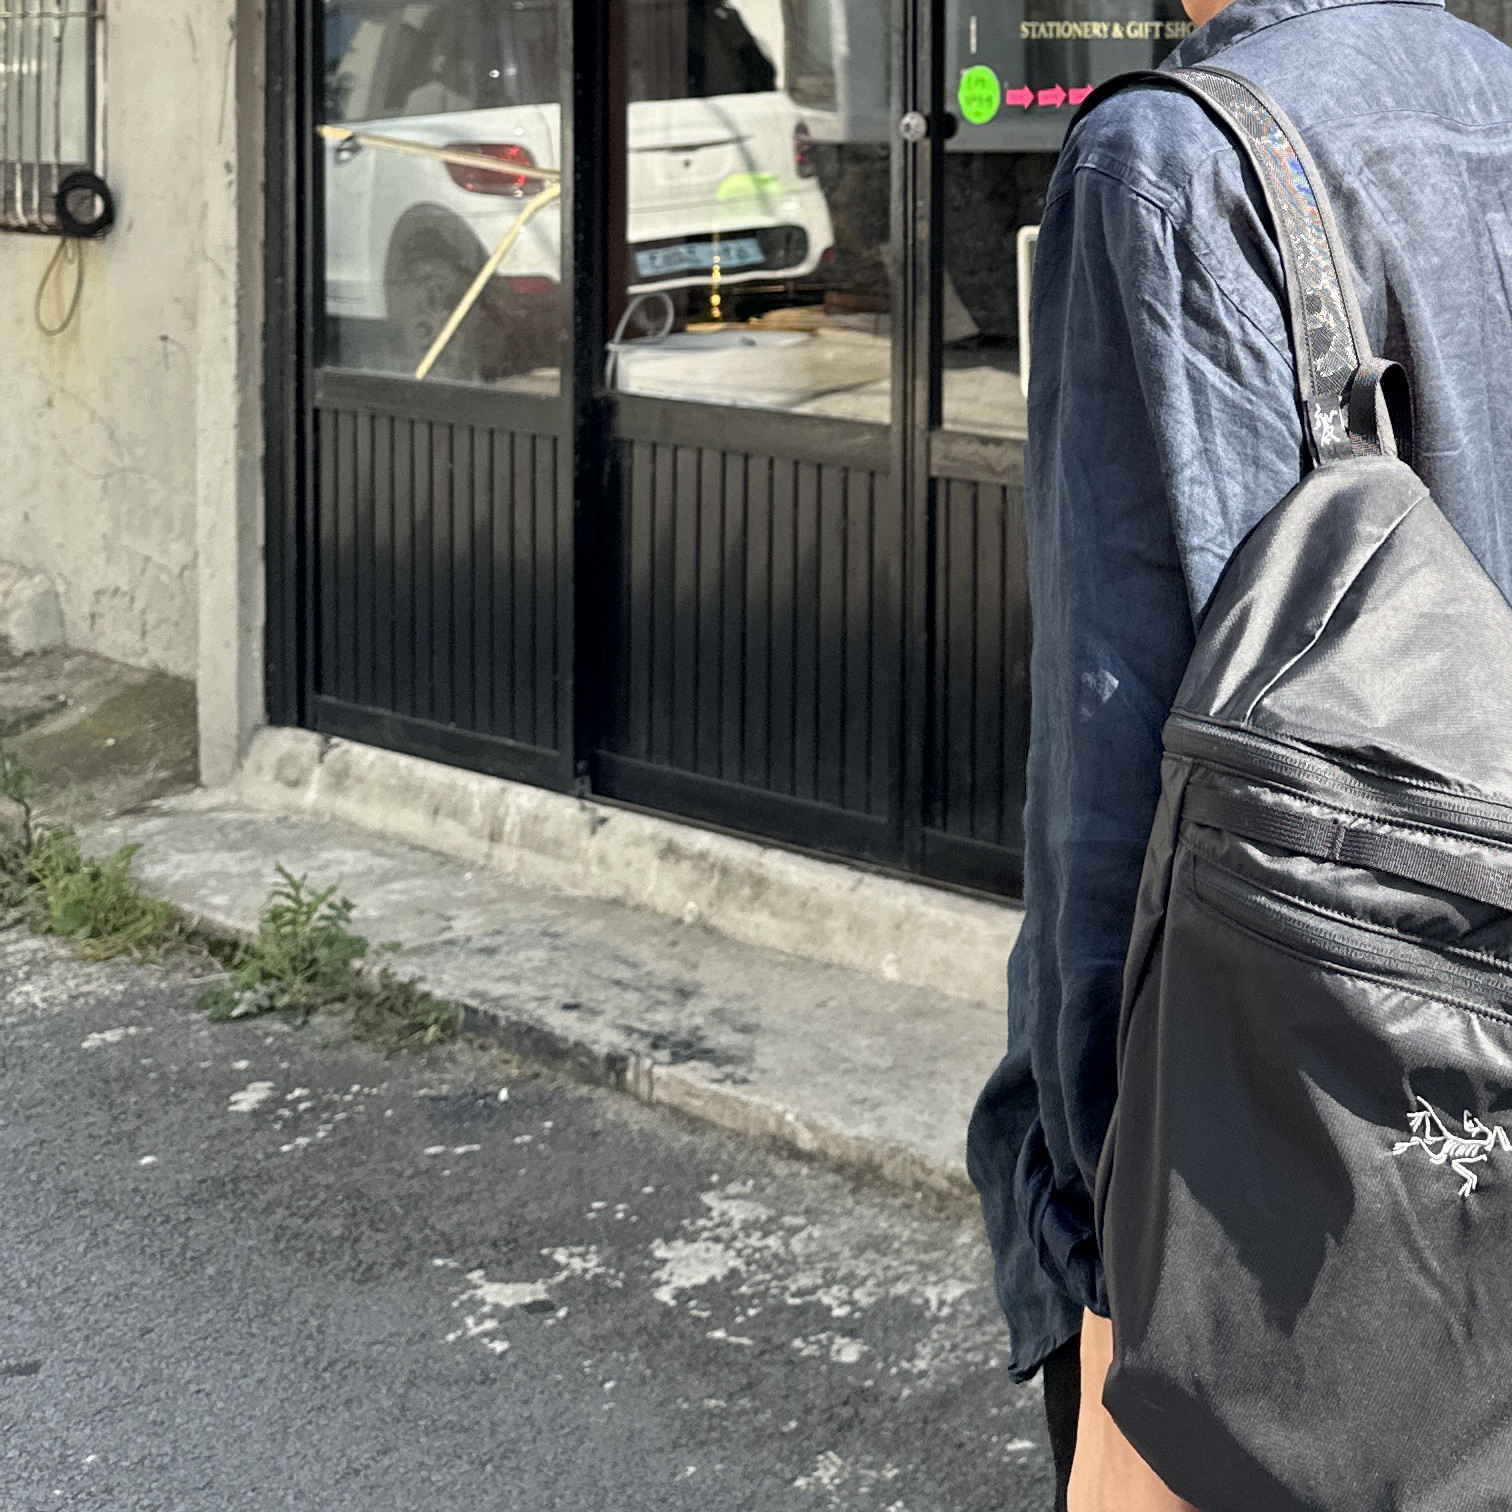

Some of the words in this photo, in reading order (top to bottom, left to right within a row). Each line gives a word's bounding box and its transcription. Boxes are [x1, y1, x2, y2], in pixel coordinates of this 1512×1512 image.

[1020, 20, 1109, 39] STATIONERY
[1112, 21, 1124, 39] &
[1126, 20, 1161, 39] GIFT
